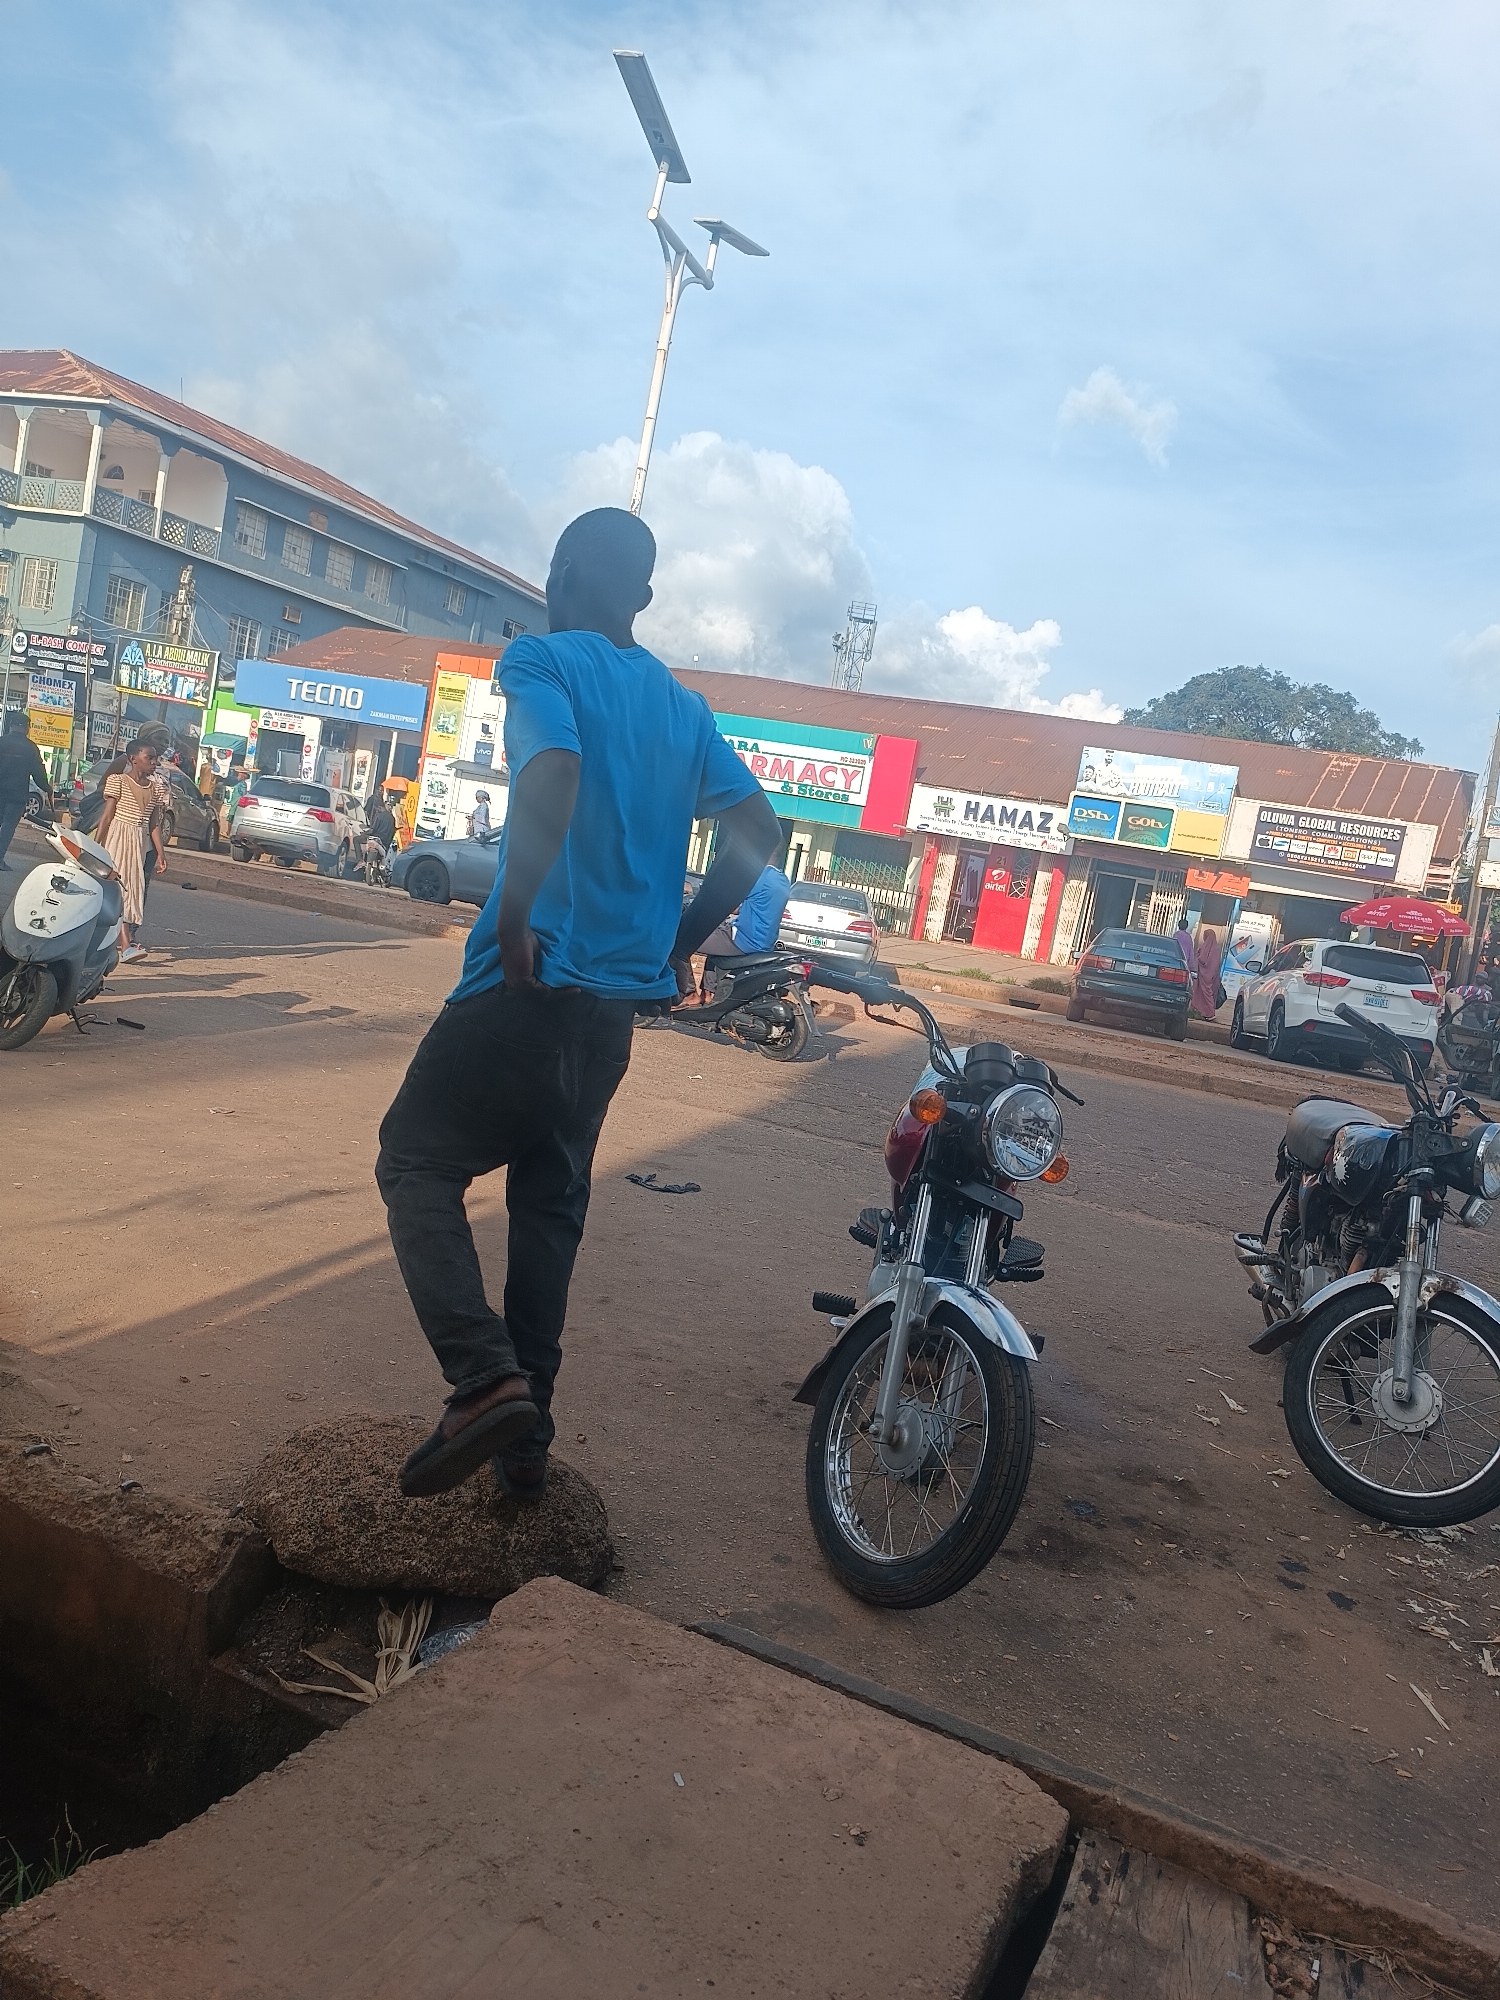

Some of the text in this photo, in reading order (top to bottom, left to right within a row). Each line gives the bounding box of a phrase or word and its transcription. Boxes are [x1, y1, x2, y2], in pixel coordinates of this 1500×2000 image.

[30, 634, 64, 649] EL-BASH
[164, 646, 210, 667] ABDULMALIK
[147, 658, 206, 674] COMMUNICATION
[32, 675, 74, 690] CHOMEX
[287, 678, 364, 710] TECNO
[94, 721, 137, 739] WHOLSALE
[736, 753, 861, 790] RMACY
[781, 781, 850, 803] & Stores
[964, 801, 1053, 833] HAMAZ
[1074, 807, 1114, 822] DStv
[1127, 816, 1169, 829] GOtv
[1260, 811, 1401, 841] OLUWA GLOBAL RESOURCES
[1311, 831, 1381, 846] COMMUNICATIONS)
[996, 857, 1007, 866] 21
[984, 881, 1006, 893] airtel
